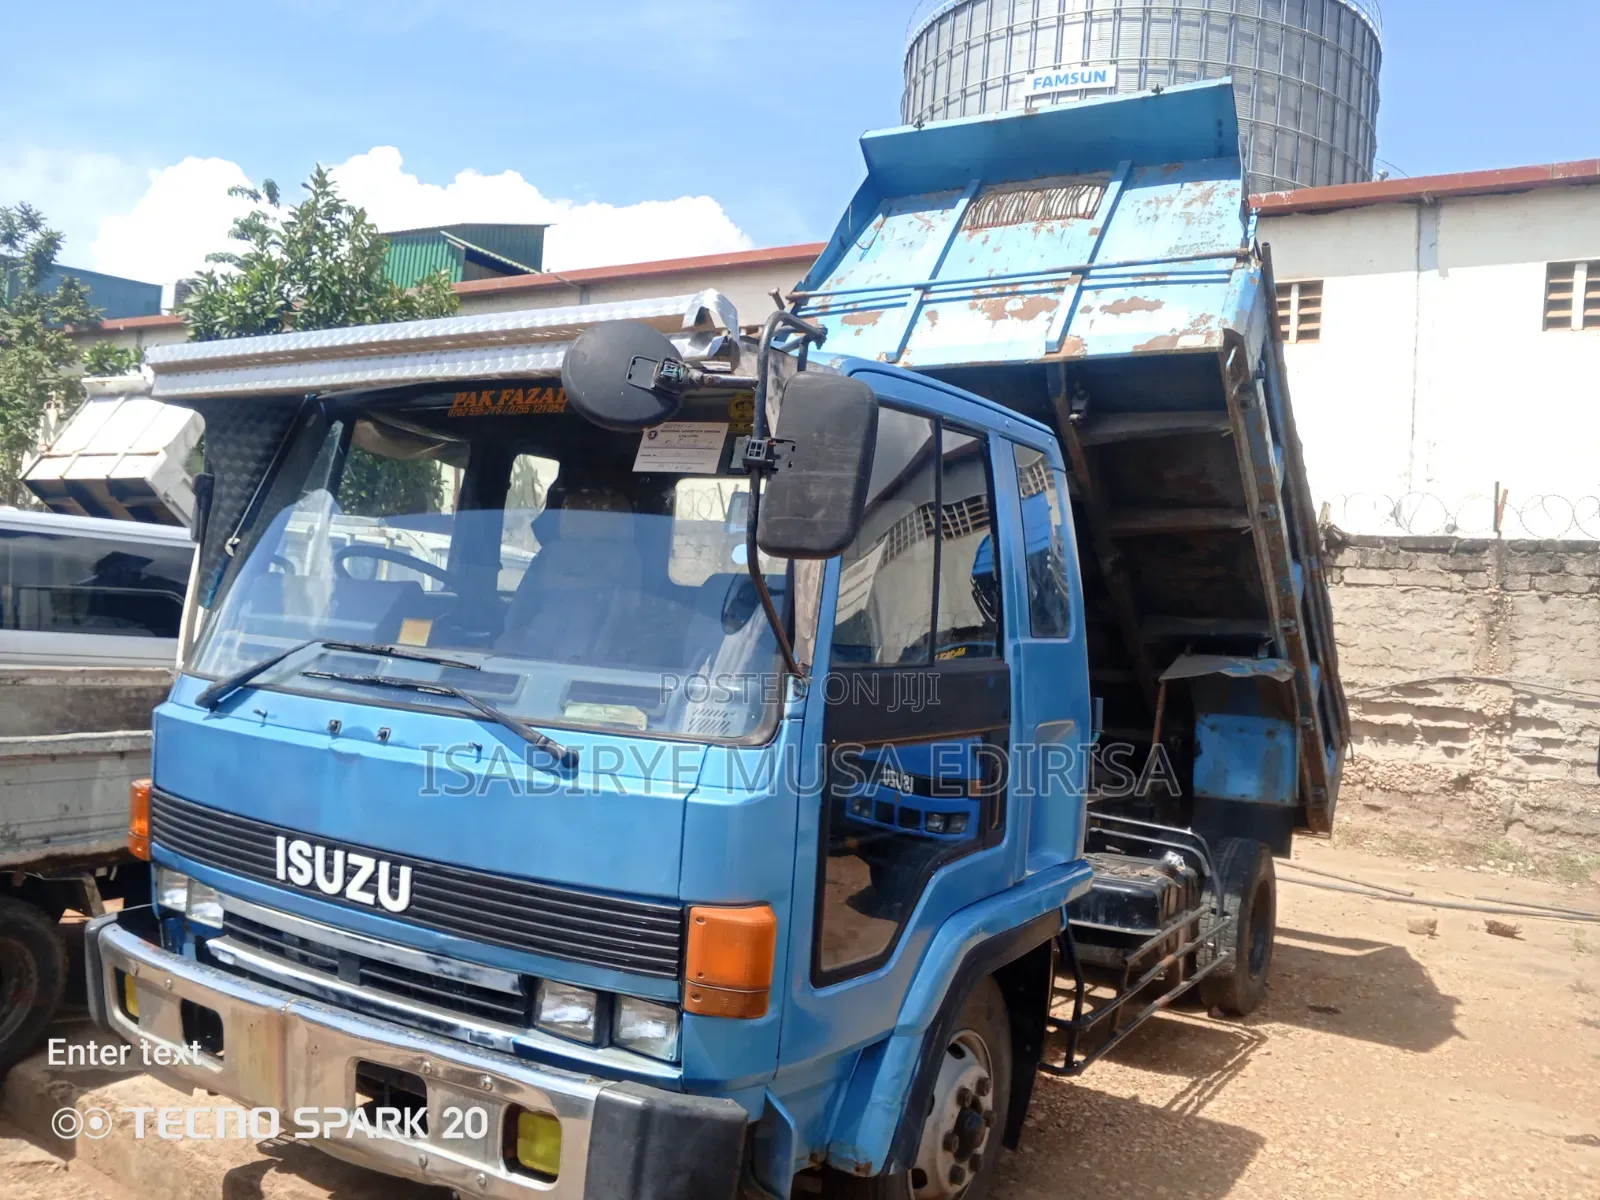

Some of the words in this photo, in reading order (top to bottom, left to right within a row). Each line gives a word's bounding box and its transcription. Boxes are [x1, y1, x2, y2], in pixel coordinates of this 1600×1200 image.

[1032, 70, 1106, 90] FAMSUN
[452, 390, 496, 409] PAK
[276, 836, 412, 912] ISUZU
